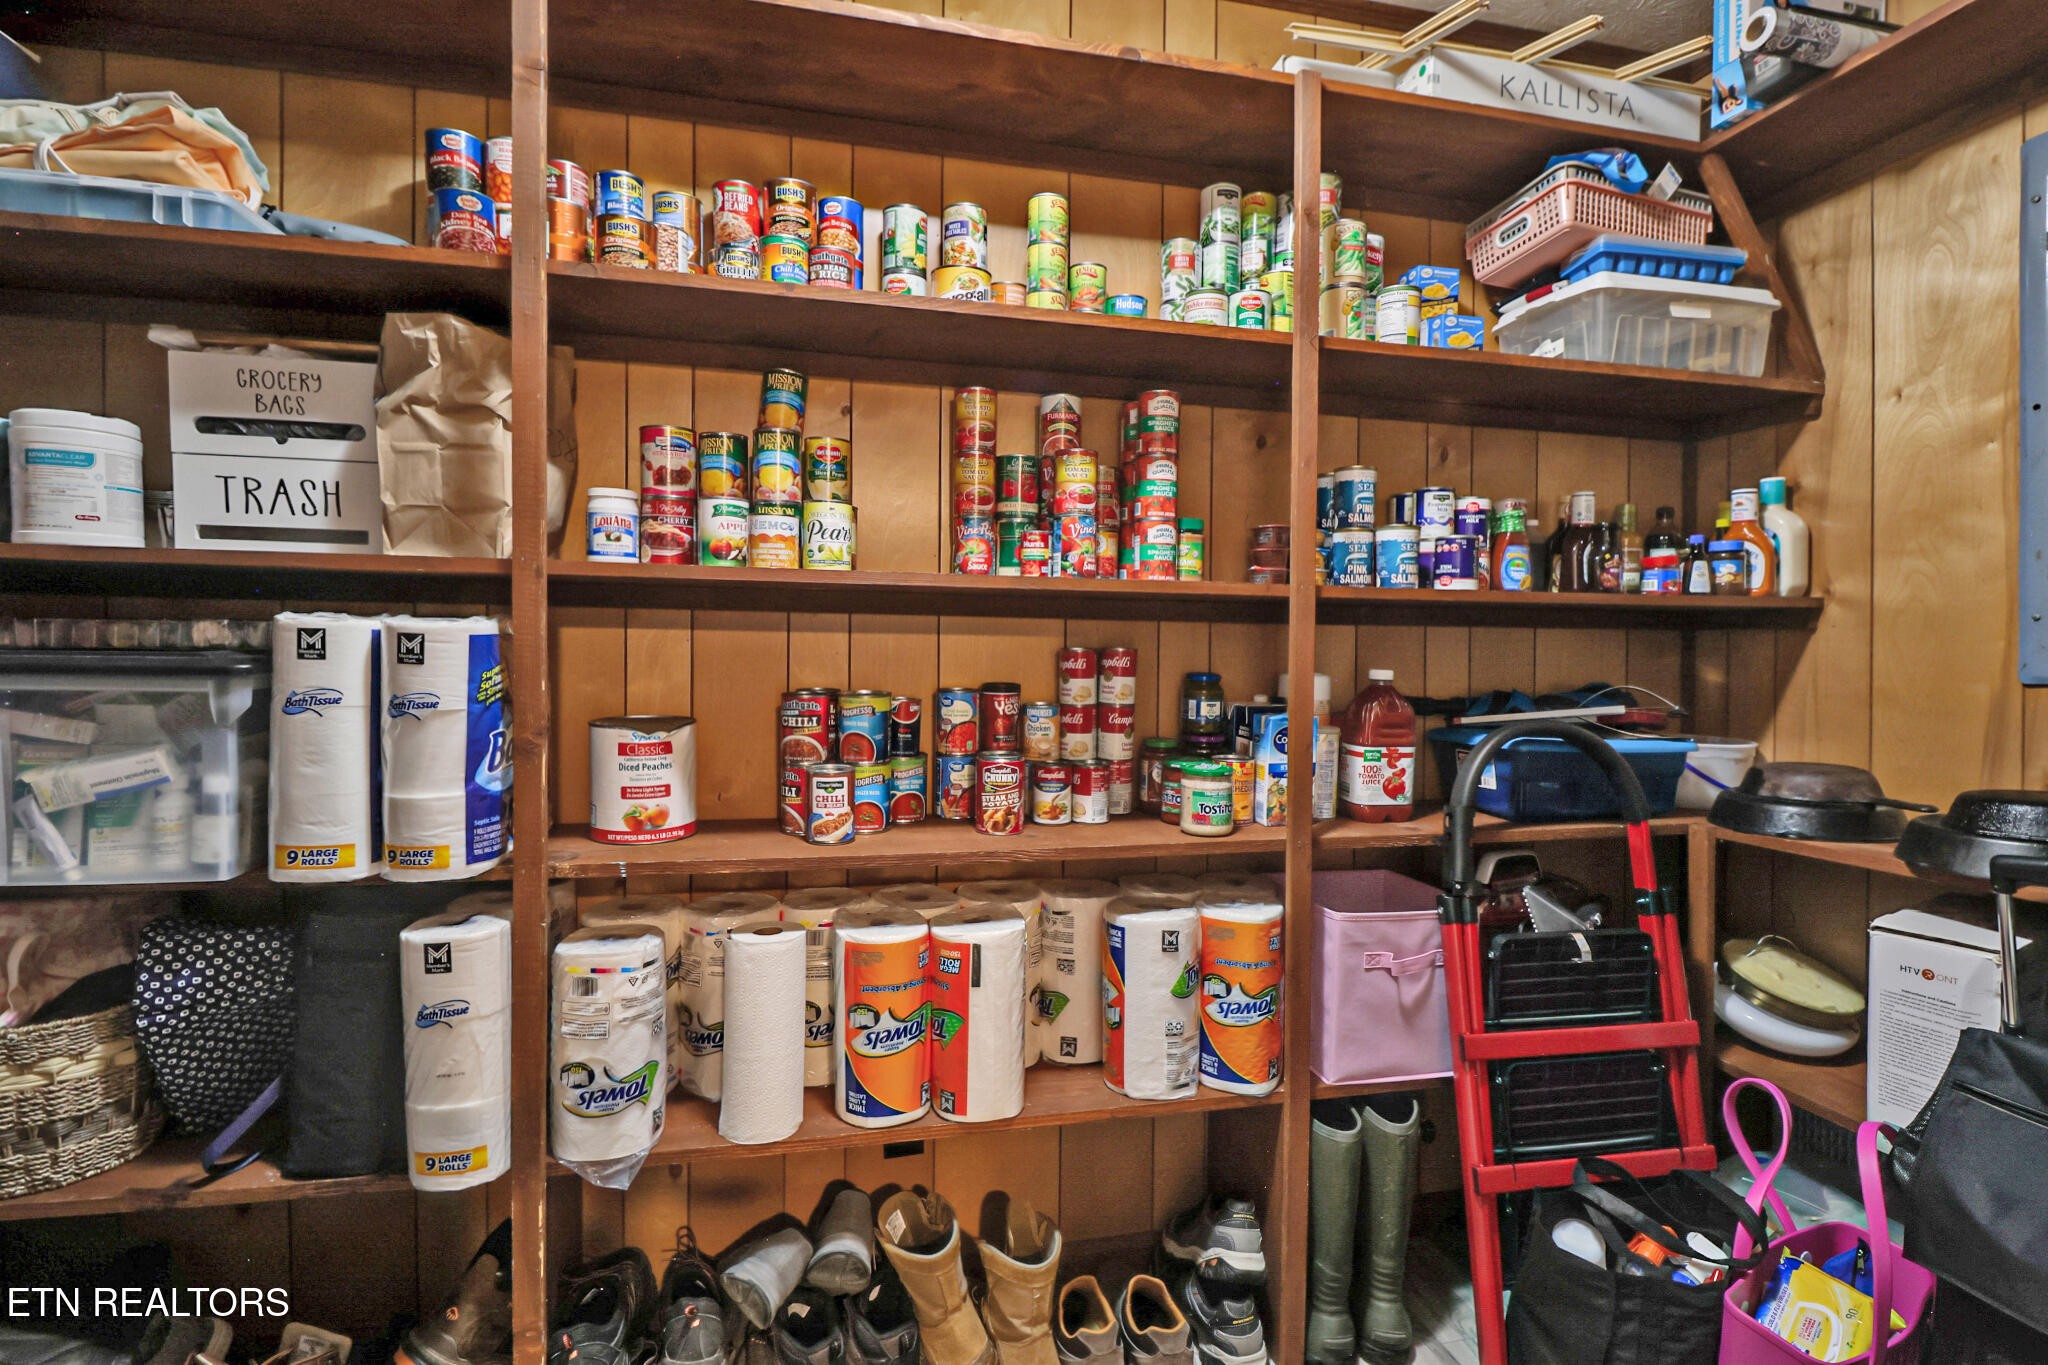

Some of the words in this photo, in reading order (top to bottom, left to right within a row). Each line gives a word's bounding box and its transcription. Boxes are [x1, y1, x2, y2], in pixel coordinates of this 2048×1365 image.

[1499, 73, 1637, 121] KALLISTA
[612, 178, 642, 197] BUSH'S
[777, 186, 806, 200] BUSH'S
[724, 191, 753, 206] REFRIED
[655, 200, 679, 210] BUSH'S
[724, 201, 749, 213] BEANS
[440, 216, 472, 230] Kidney
[608, 221, 639, 235] BUSH'S
[726, 254, 750, 264] BUSH'S
[818, 270, 848, 282] RICE
[1115, 297, 1143, 311] Hudson
[236, 368, 323, 394] GROCERY
[768, 373, 803, 389] MISSION
[773, 382, 796, 393] PRIDE
[255, 393, 306, 416] BAGS
[1047, 412, 1078, 422] FURMAN'S
[758, 432, 795, 449] MISSION
[1064, 466, 1092, 474] TOMATO
[1152, 489, 1173, 497] SAUCE
[1358, 483, 1374, 492] SEA
[215, 475, 343, 518] TRASH
[758, 506, 795, 516] MISSION
[594, 515, 632, 529] LouAna
[657, 516, 689, 525] CHERRY
[1348, 513, 1374, 523] SALMO
[1348, 544, 1368, 552] SEA
[967, 560, 988, 571] Sauce
[1347, 564, 1367, 574] PINK
[1339, 573, 1372, 584] SALMON
[782, 715, 818, 728] CHILI
[1027, 724, 1052, 734] Chicken
[626, 743, 666, 756] Classic
[618, 762, 640, 772] Diced
[642, 761, 673, 772] Peaches
[893, 766, 924, 778] PROGRESSO
[855, 775, 884, 787] ROGRESSO
[984, 772, 1019, 783] CHUNKY
[815, 794, 845, 803] CHILI
[982, 794, 1007, 802] STEAK
[1007, 792, 1020, 800] AND
[982, 799, 1021, 808] POTATO
[637, 833, 651, 841] NETO
[286, 850, 299, 866] 9
[301, 848, 339, 859] LARGE
[387, 850, 397, 863] 9
[400, 849, 434, 859] LARGE
[939, 957, 961, 967] ROLL
[939, 964, 960, 974] MEGA
[861, 983, 902, 994] Absorbent
[1217, 993, 1275, 1019] Towels
[864, 1011, 926, 1050] Towels
[577, 1077, 650, 1110] Towels
[848, 1102, 867, 1113] THICK
[425, 1157, 436, 1171] 9
[438, 1152, 472, 1164] LARGE
